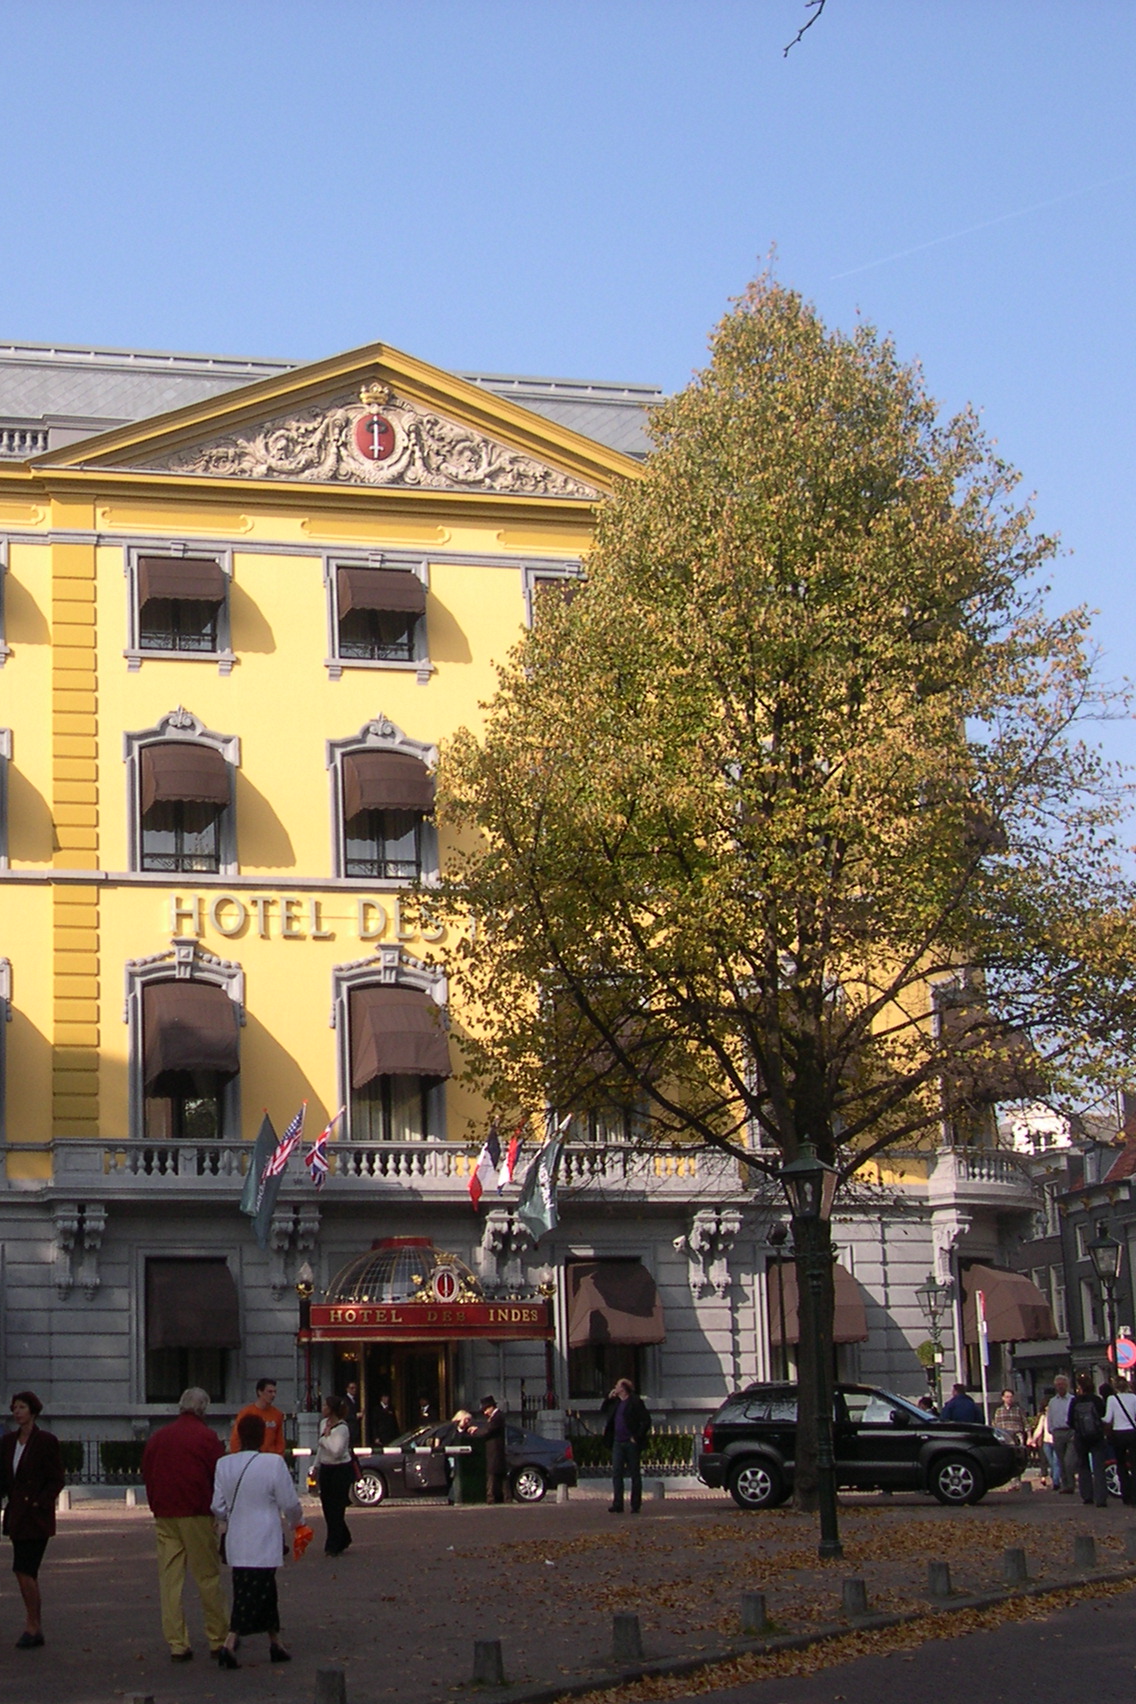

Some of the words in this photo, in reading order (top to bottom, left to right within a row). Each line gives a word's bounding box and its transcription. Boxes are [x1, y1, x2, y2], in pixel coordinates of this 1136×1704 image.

[169, 893, 331, 937] HOTEL
[329, 1309, 403, 1323] HOTEL
[426, 1310, 466, 1322] DES
[489, 1308, 539, 1322] INDES
